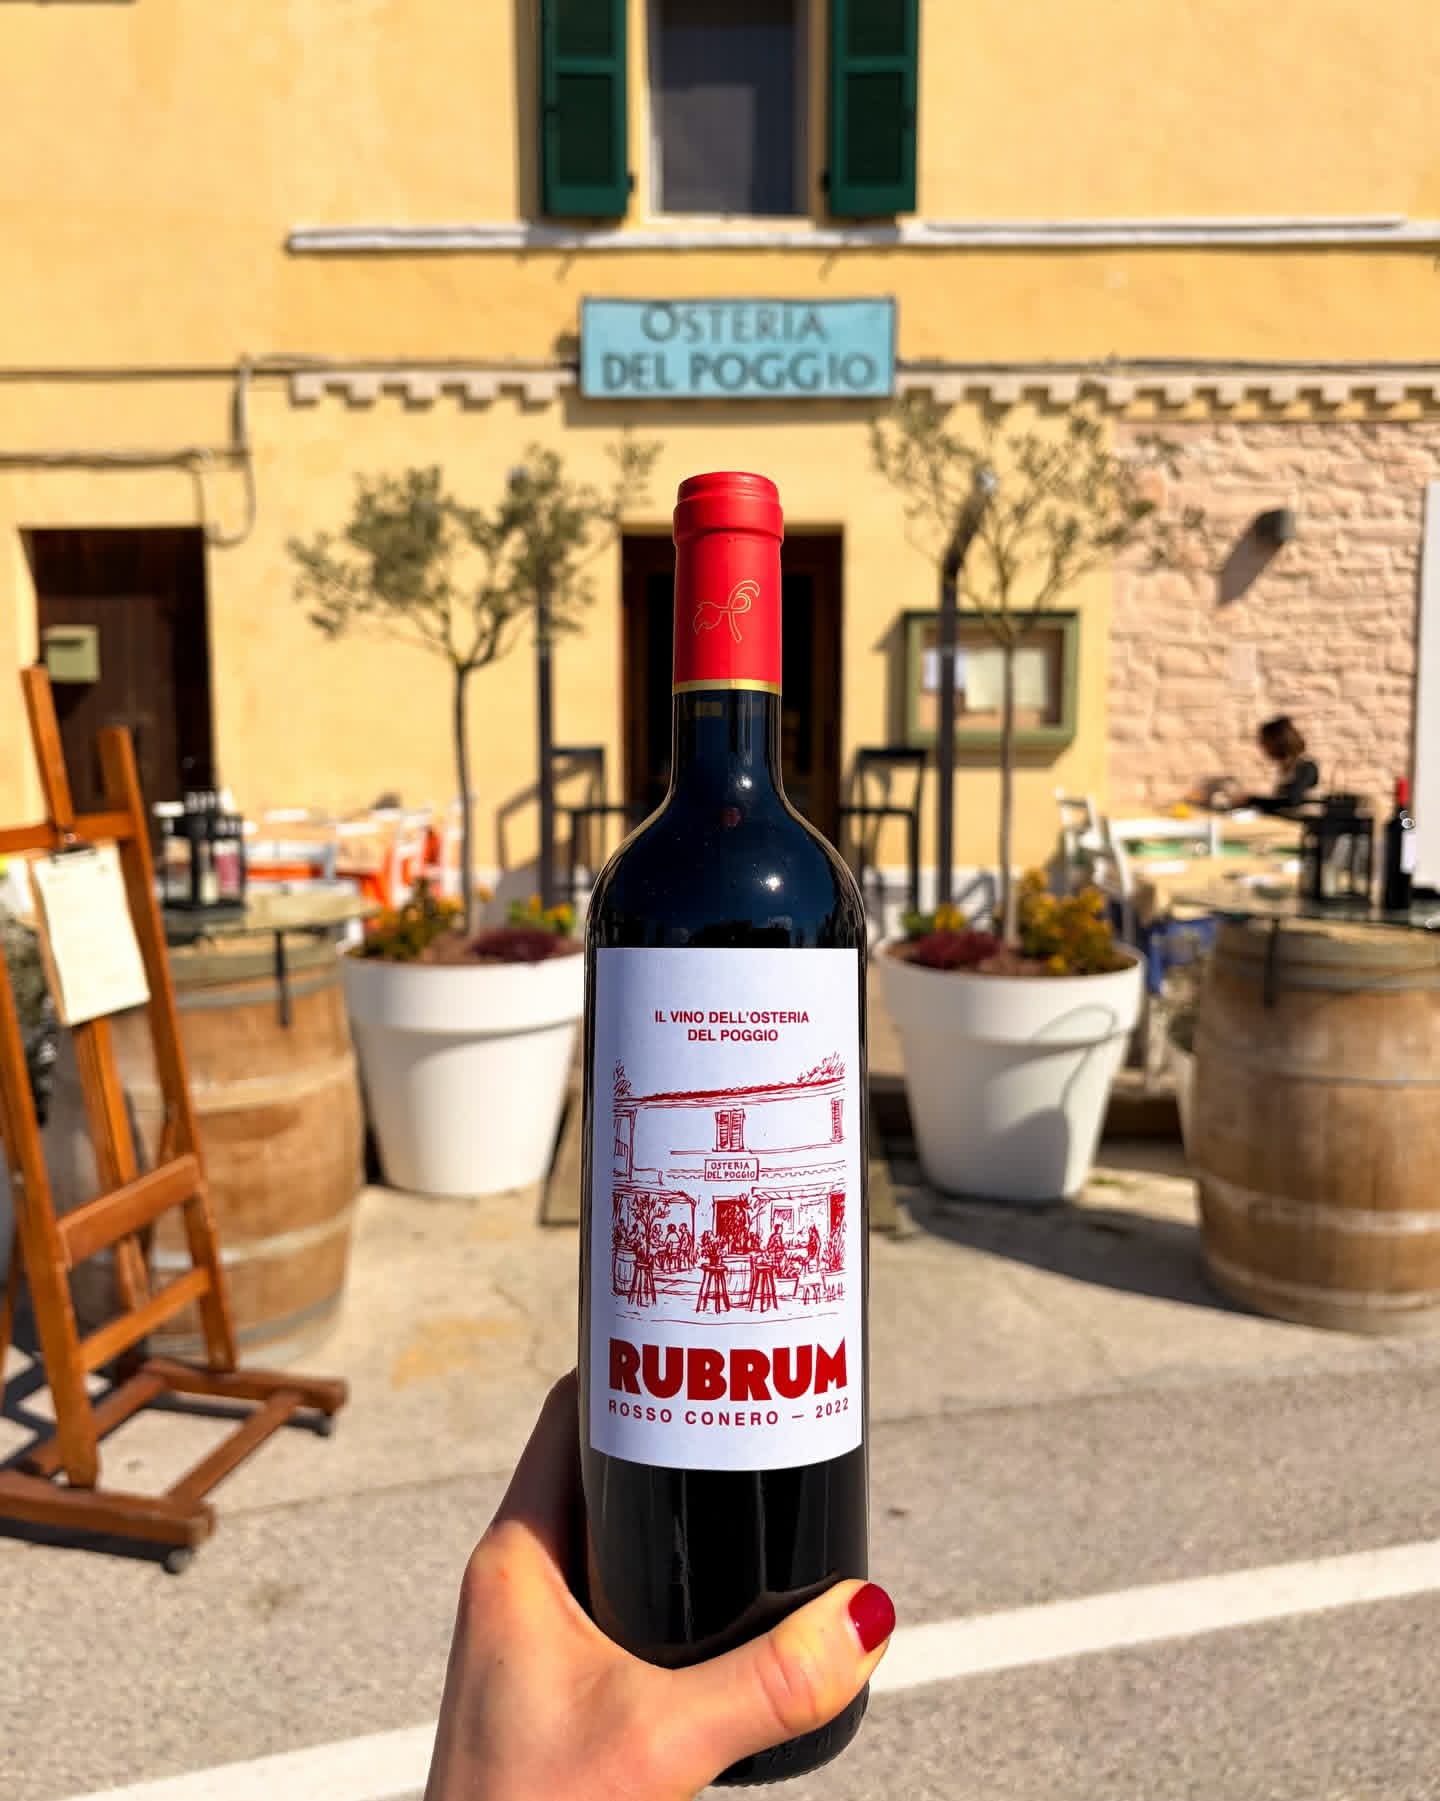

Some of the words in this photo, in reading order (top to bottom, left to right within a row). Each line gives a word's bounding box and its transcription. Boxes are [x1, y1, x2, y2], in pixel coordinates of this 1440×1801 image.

[640, 301, 830, 342] OSTERIA
[602, 352, 675, 391] DEL
[690, 351, 877, 391] POGGIO
[655, 1011, 666, 1023] IL
[671, 1011, 704, 1024] VINO
[709, 1011, 809, 1024] DELL'OSTERIA
[688, 1029, 716, 1041] DEL
[720, 1029, 778, 1042] POGGIO
[707, 1171, 722, 1179] DEL
[724, 1170, 755, 1178] POGGIO
[711, 1162, 750, 1170] OSTERIA
[608, 1336, 847, 1401] RUBRUM
[608, 1400, 672, 1423] ROSSO
[685, 1411, 778, 1426] CONERO
[815, 1397, 849, 1418] 2022
